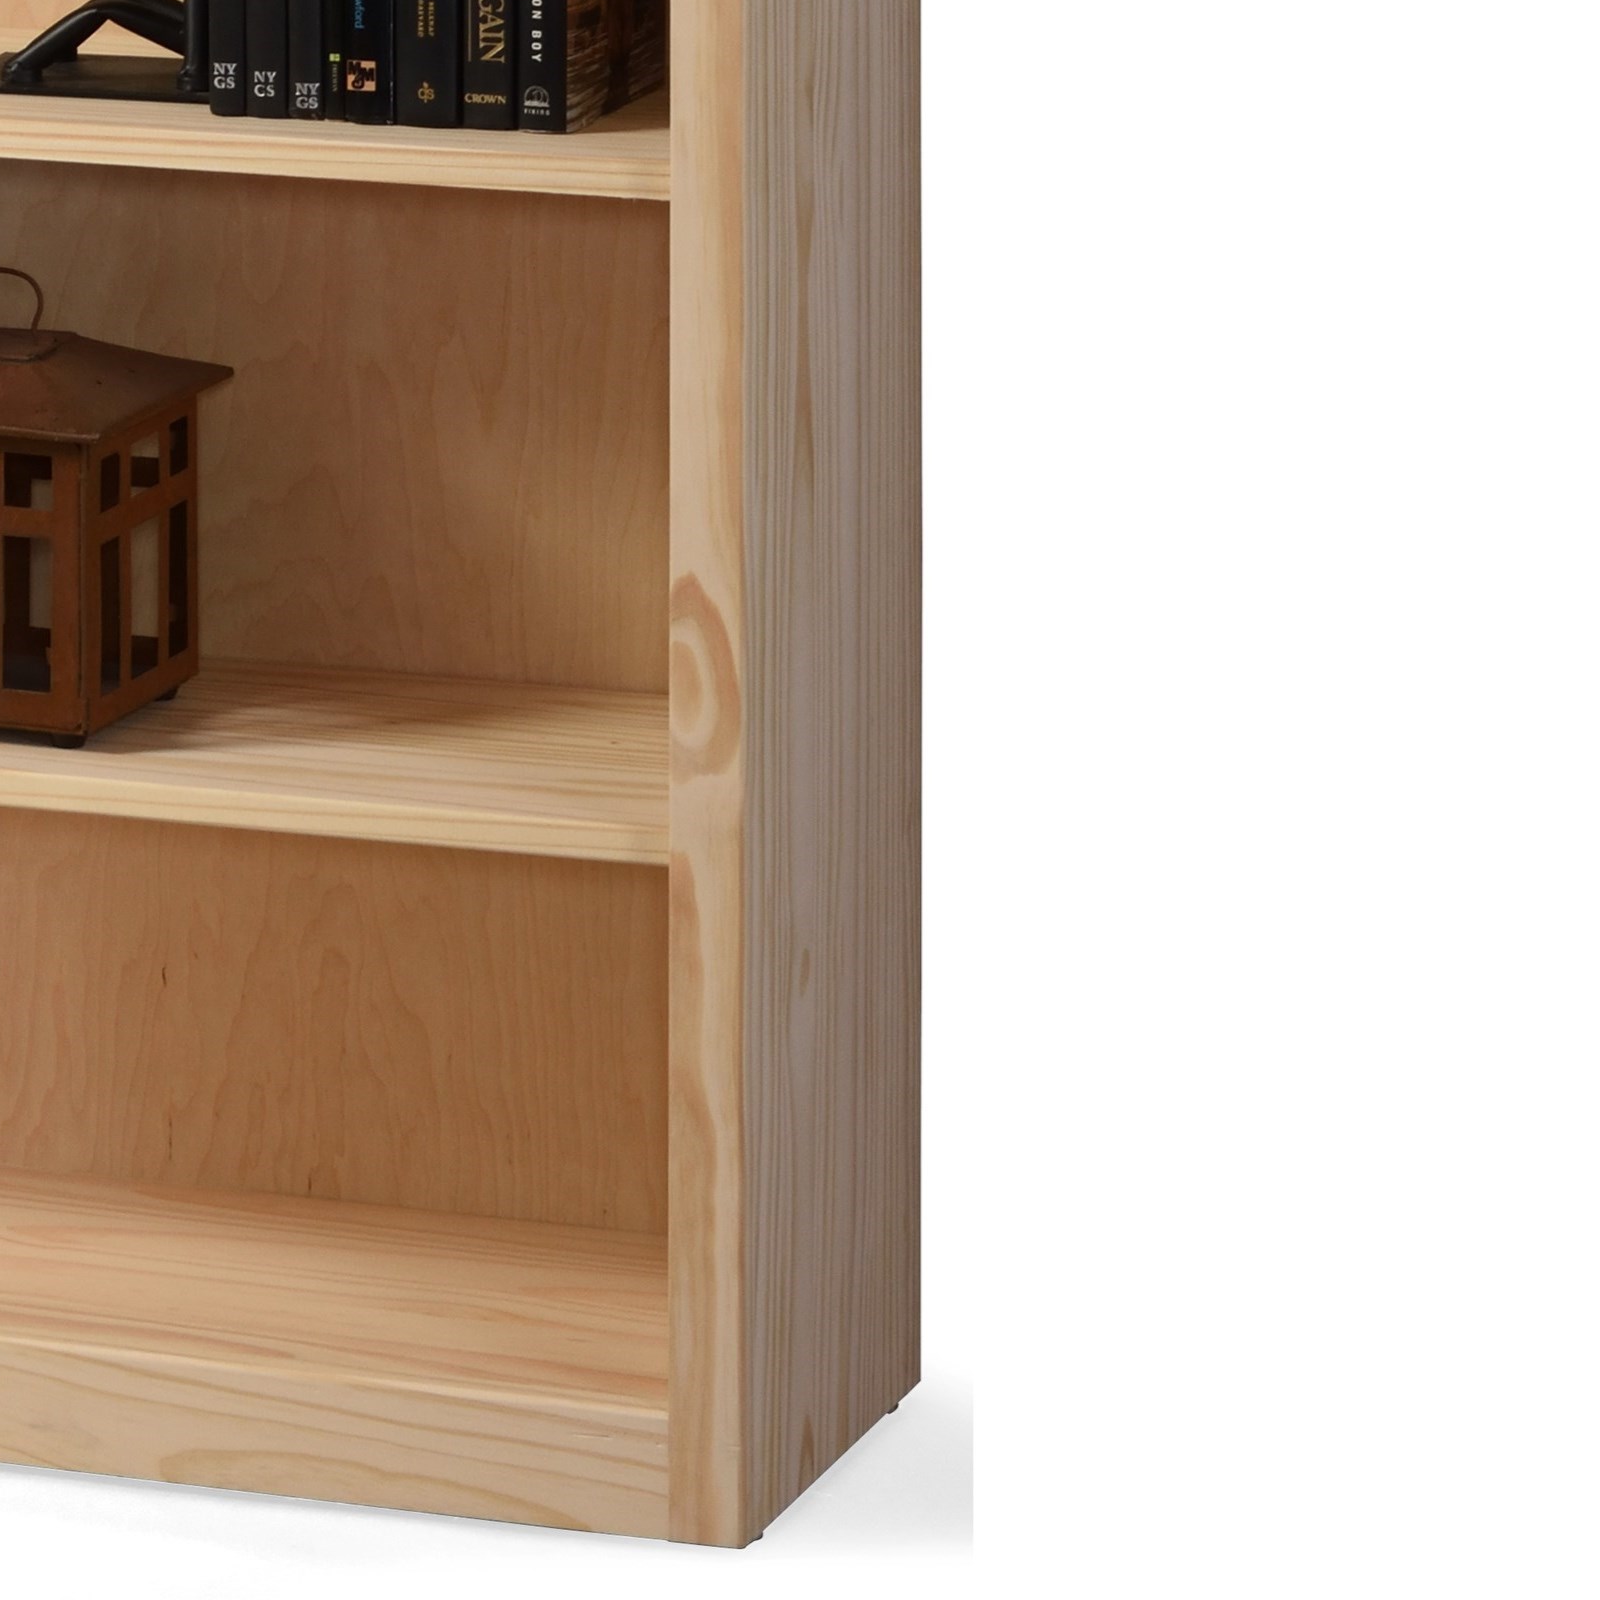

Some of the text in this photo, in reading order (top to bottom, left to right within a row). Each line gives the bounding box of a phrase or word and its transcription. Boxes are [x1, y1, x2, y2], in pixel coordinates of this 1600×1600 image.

[531, 30, 542, 62] BOY
[213, 63, 237, 75] NY
[213, 77, 236, 89] GS
[254, 71, 277, 83] NY
[295, 83, 320, 95] NY
[295, 96, 319, 109] GS
[464, 93, 507, 105] CROWN
